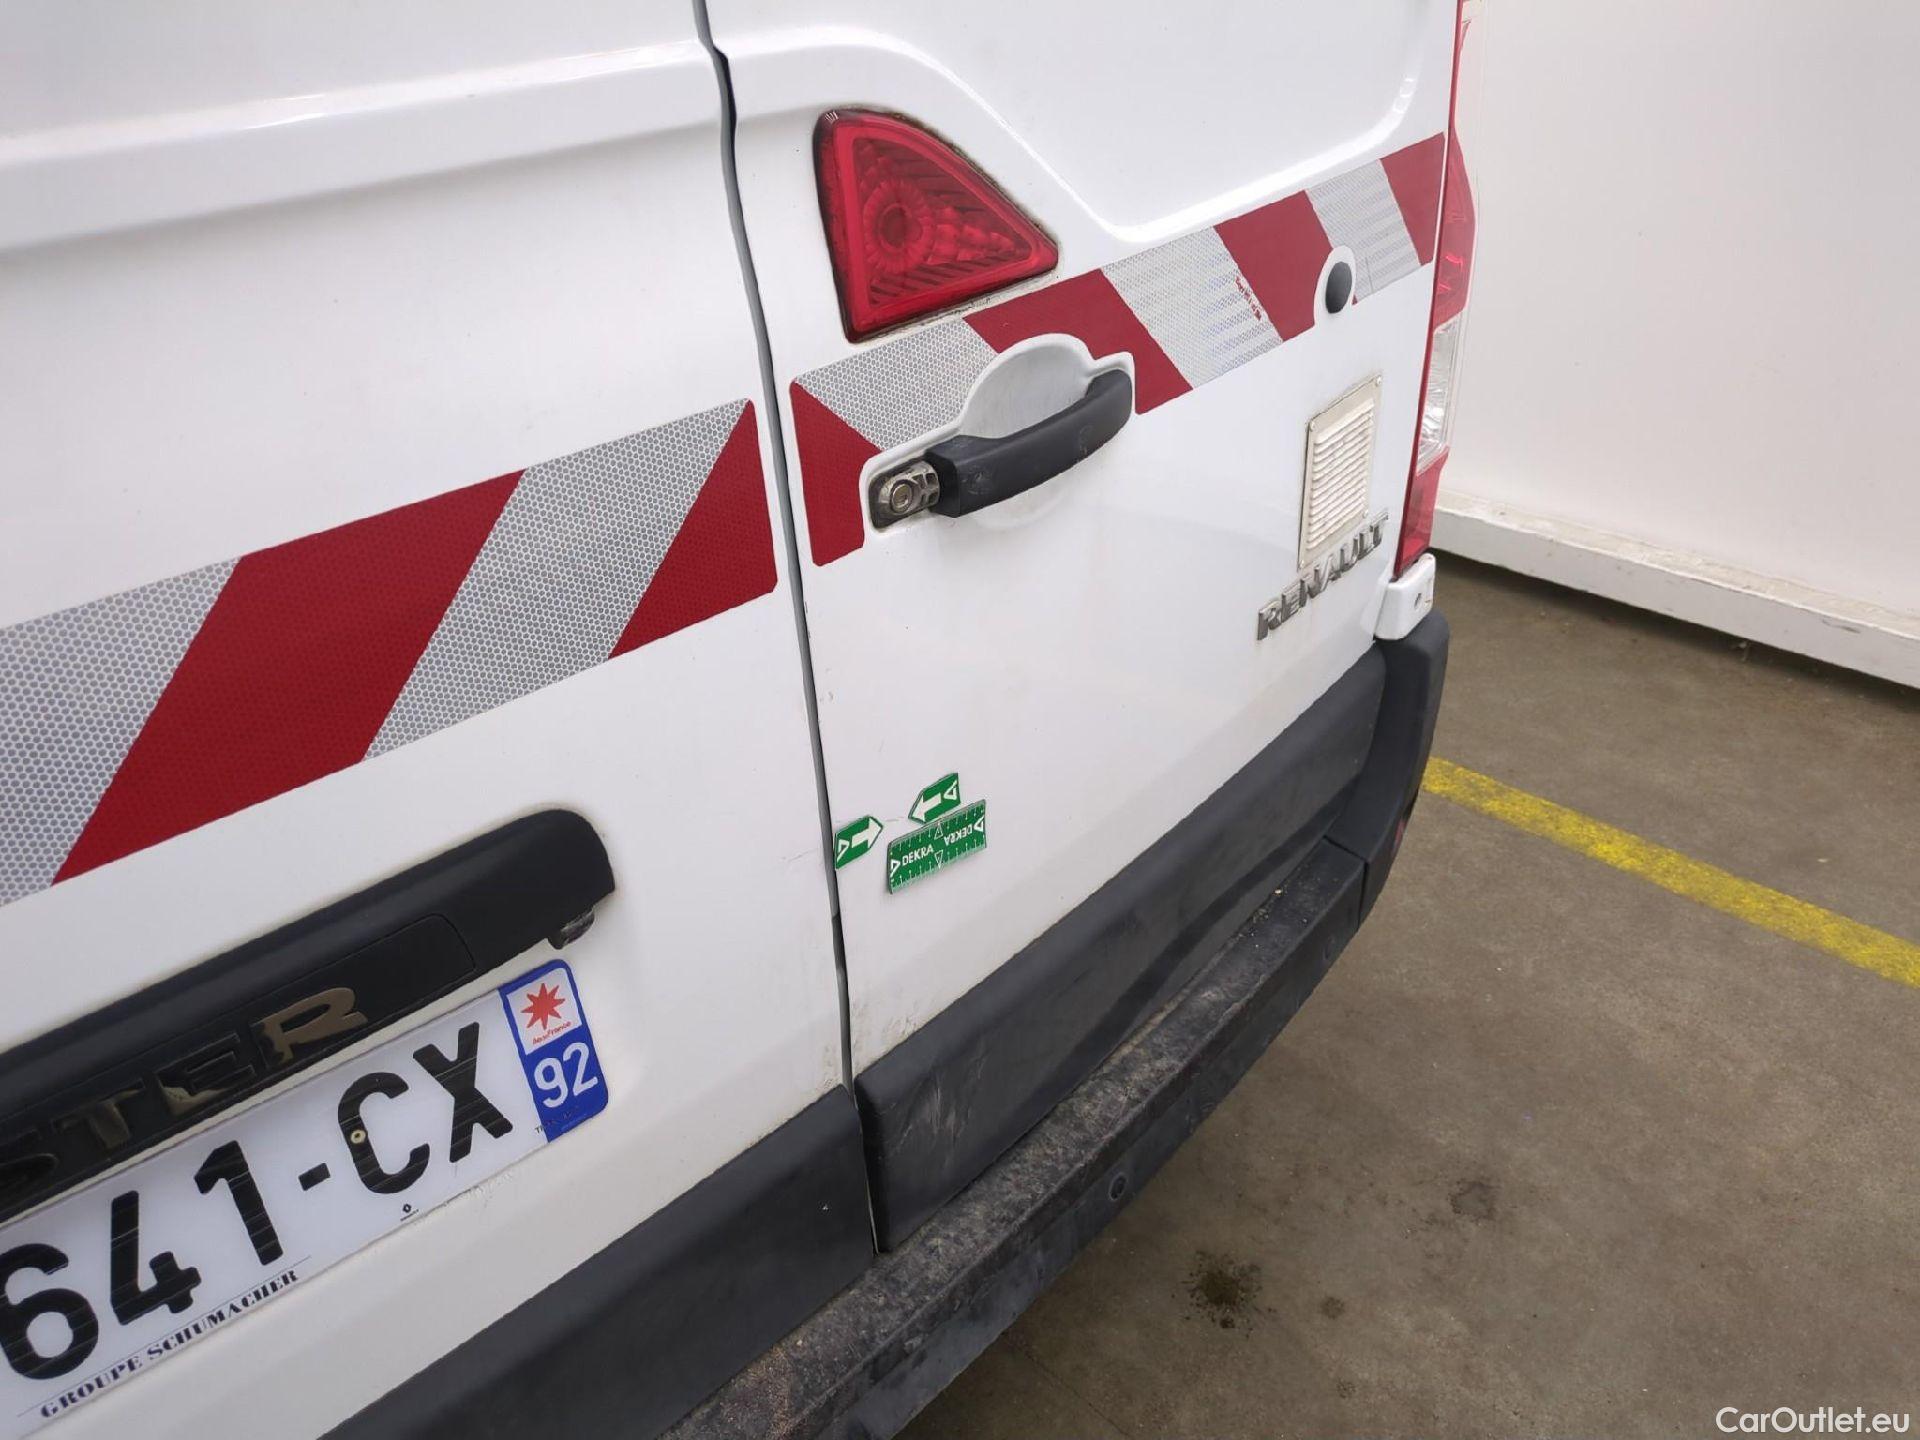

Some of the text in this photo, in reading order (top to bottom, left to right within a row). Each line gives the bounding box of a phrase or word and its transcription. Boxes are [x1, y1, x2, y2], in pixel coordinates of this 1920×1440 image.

[1257, 512, 1389, 640] RENAULT
[902, 845, 934, 866] DEKRA
[943, 824, 973, 846] DEKRA
[534, 1042, 599, 1109] 92
[40, 1269, 299, 1418] GROUPE SCHUMACHER
